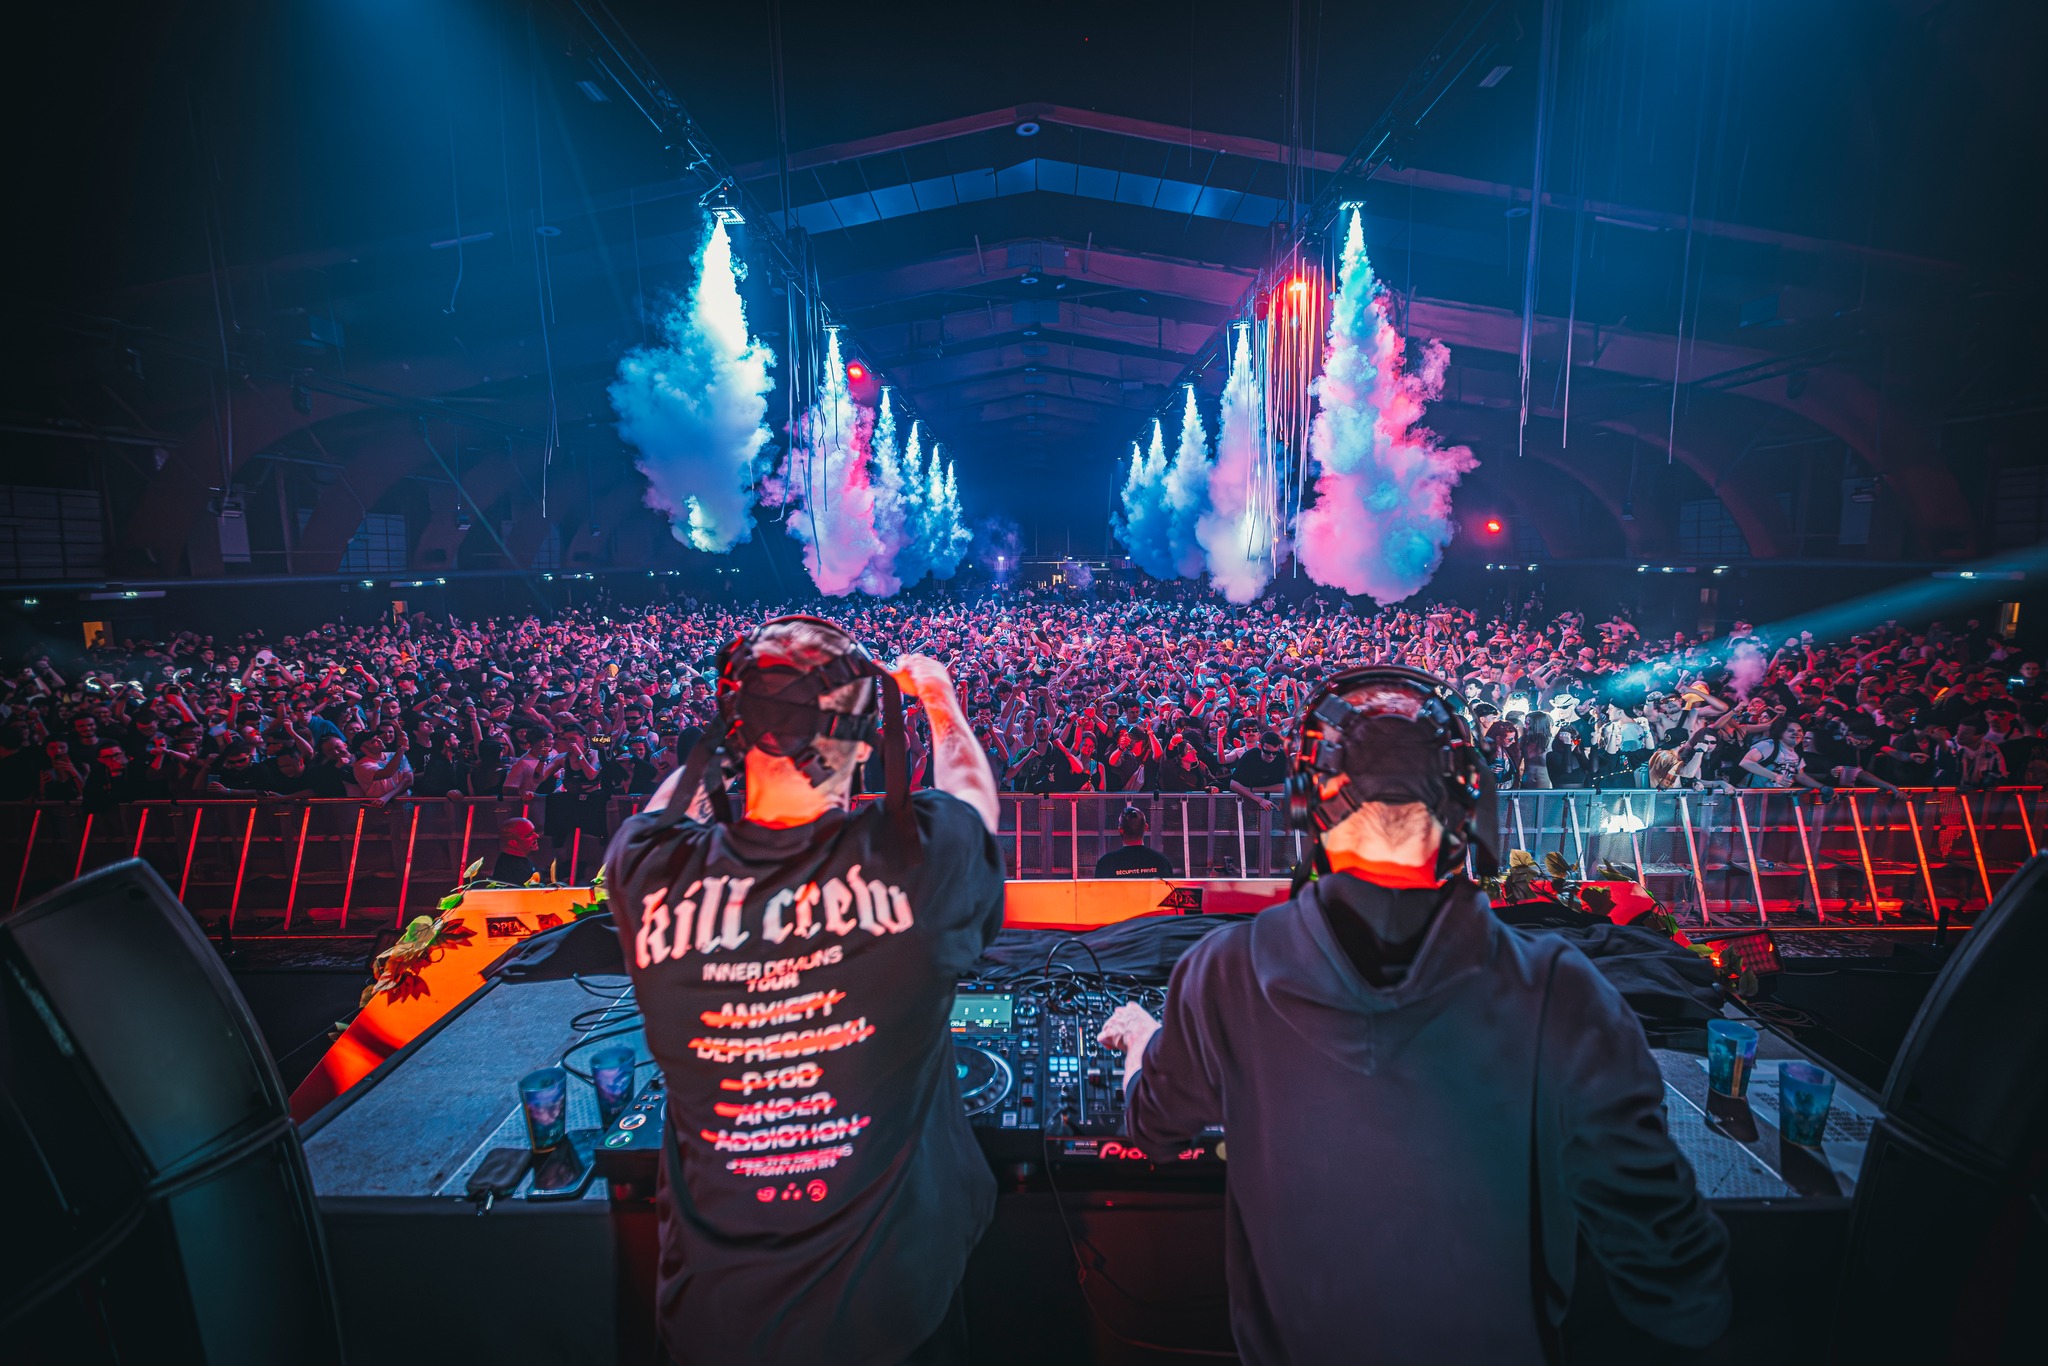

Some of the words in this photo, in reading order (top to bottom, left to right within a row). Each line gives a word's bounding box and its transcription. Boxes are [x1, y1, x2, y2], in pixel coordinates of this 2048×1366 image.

[635, 874, 756, 970] kill
[761, 864, 914, 945] crew
[702, 961, 763, 983] INNER
[763, 945, 844, 978] DEMONS
[746, 972, 800, 993] TOUR
[713, 1113, 863, 1153] ADDICTION
